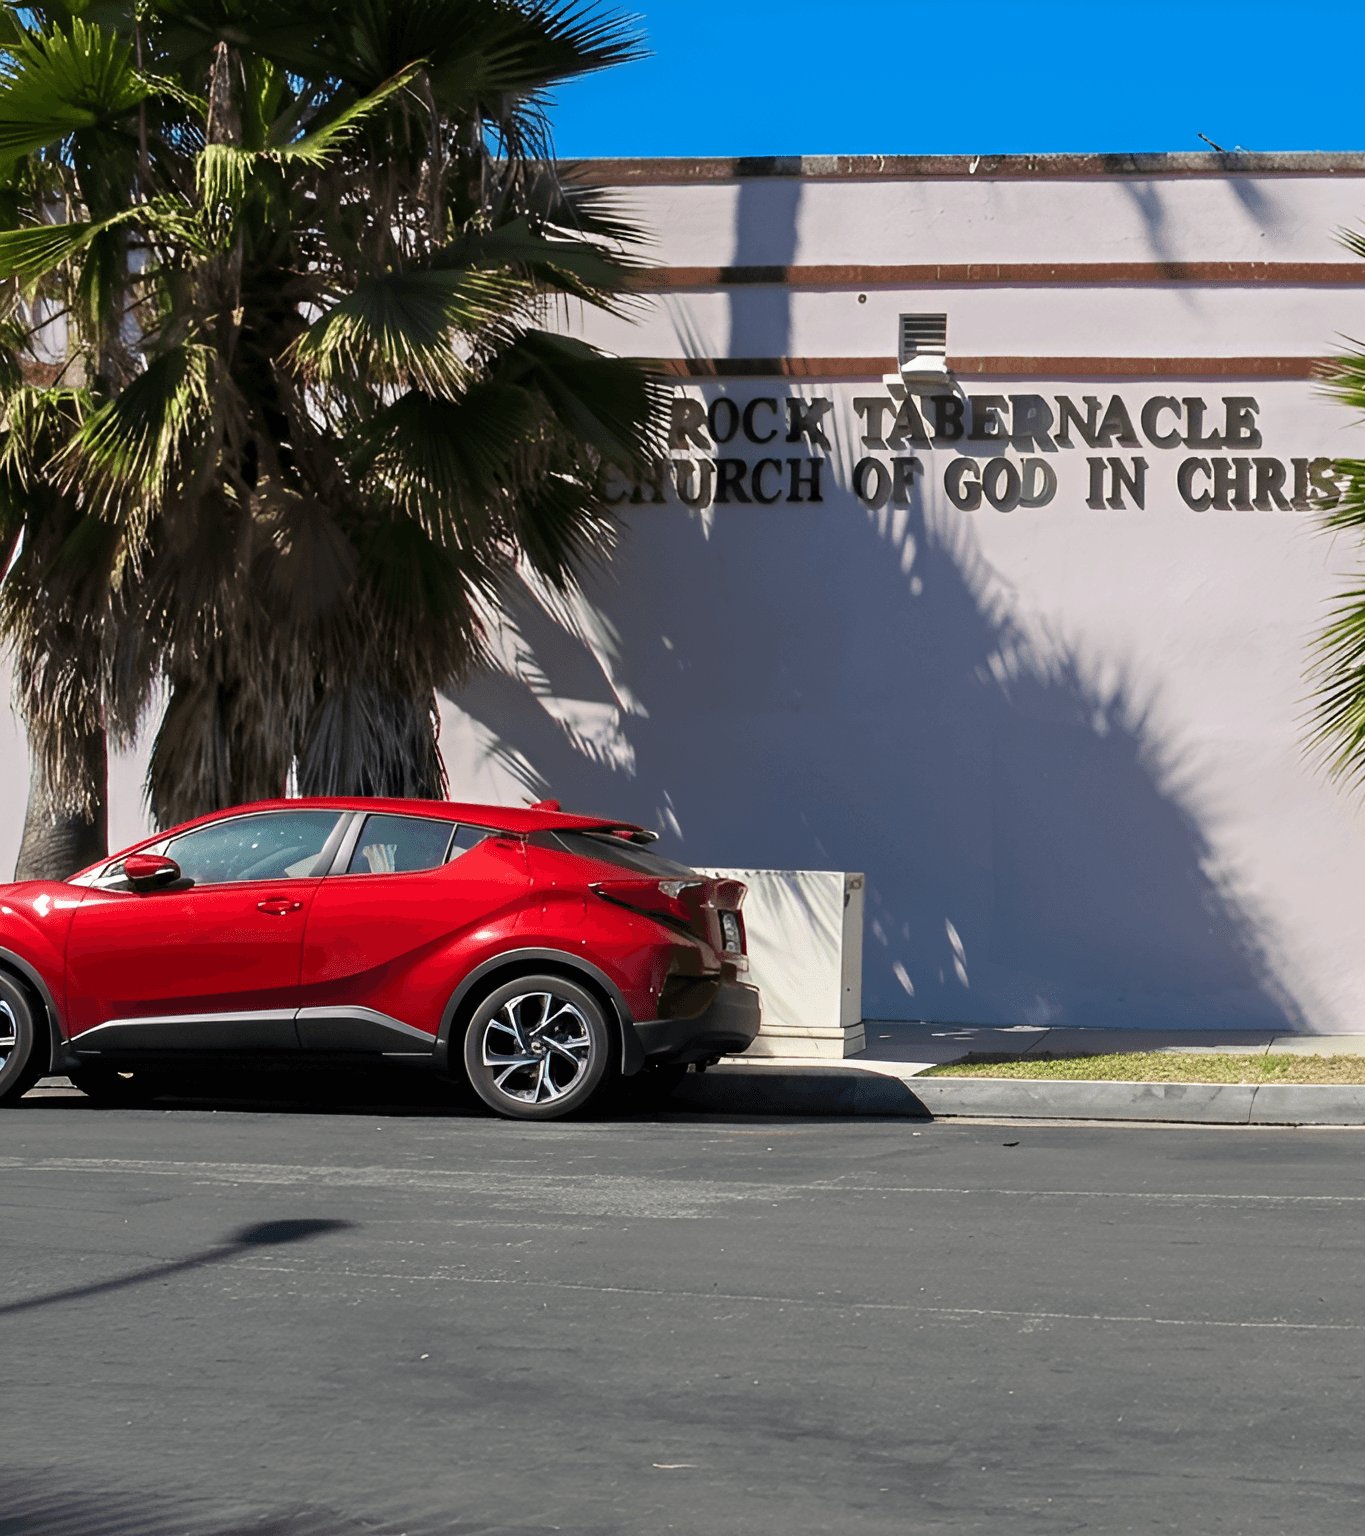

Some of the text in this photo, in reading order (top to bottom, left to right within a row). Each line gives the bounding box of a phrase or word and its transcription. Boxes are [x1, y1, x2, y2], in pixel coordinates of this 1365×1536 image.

[668, 394, 1263, 452] ROCK TABERNACLE
[852, 456, 924, 511] OF
[943, 456, 1058, 512] GOD
[1085, 456, 1149, 511] IN
[1177, 456, 1343, 511] CHRIS
